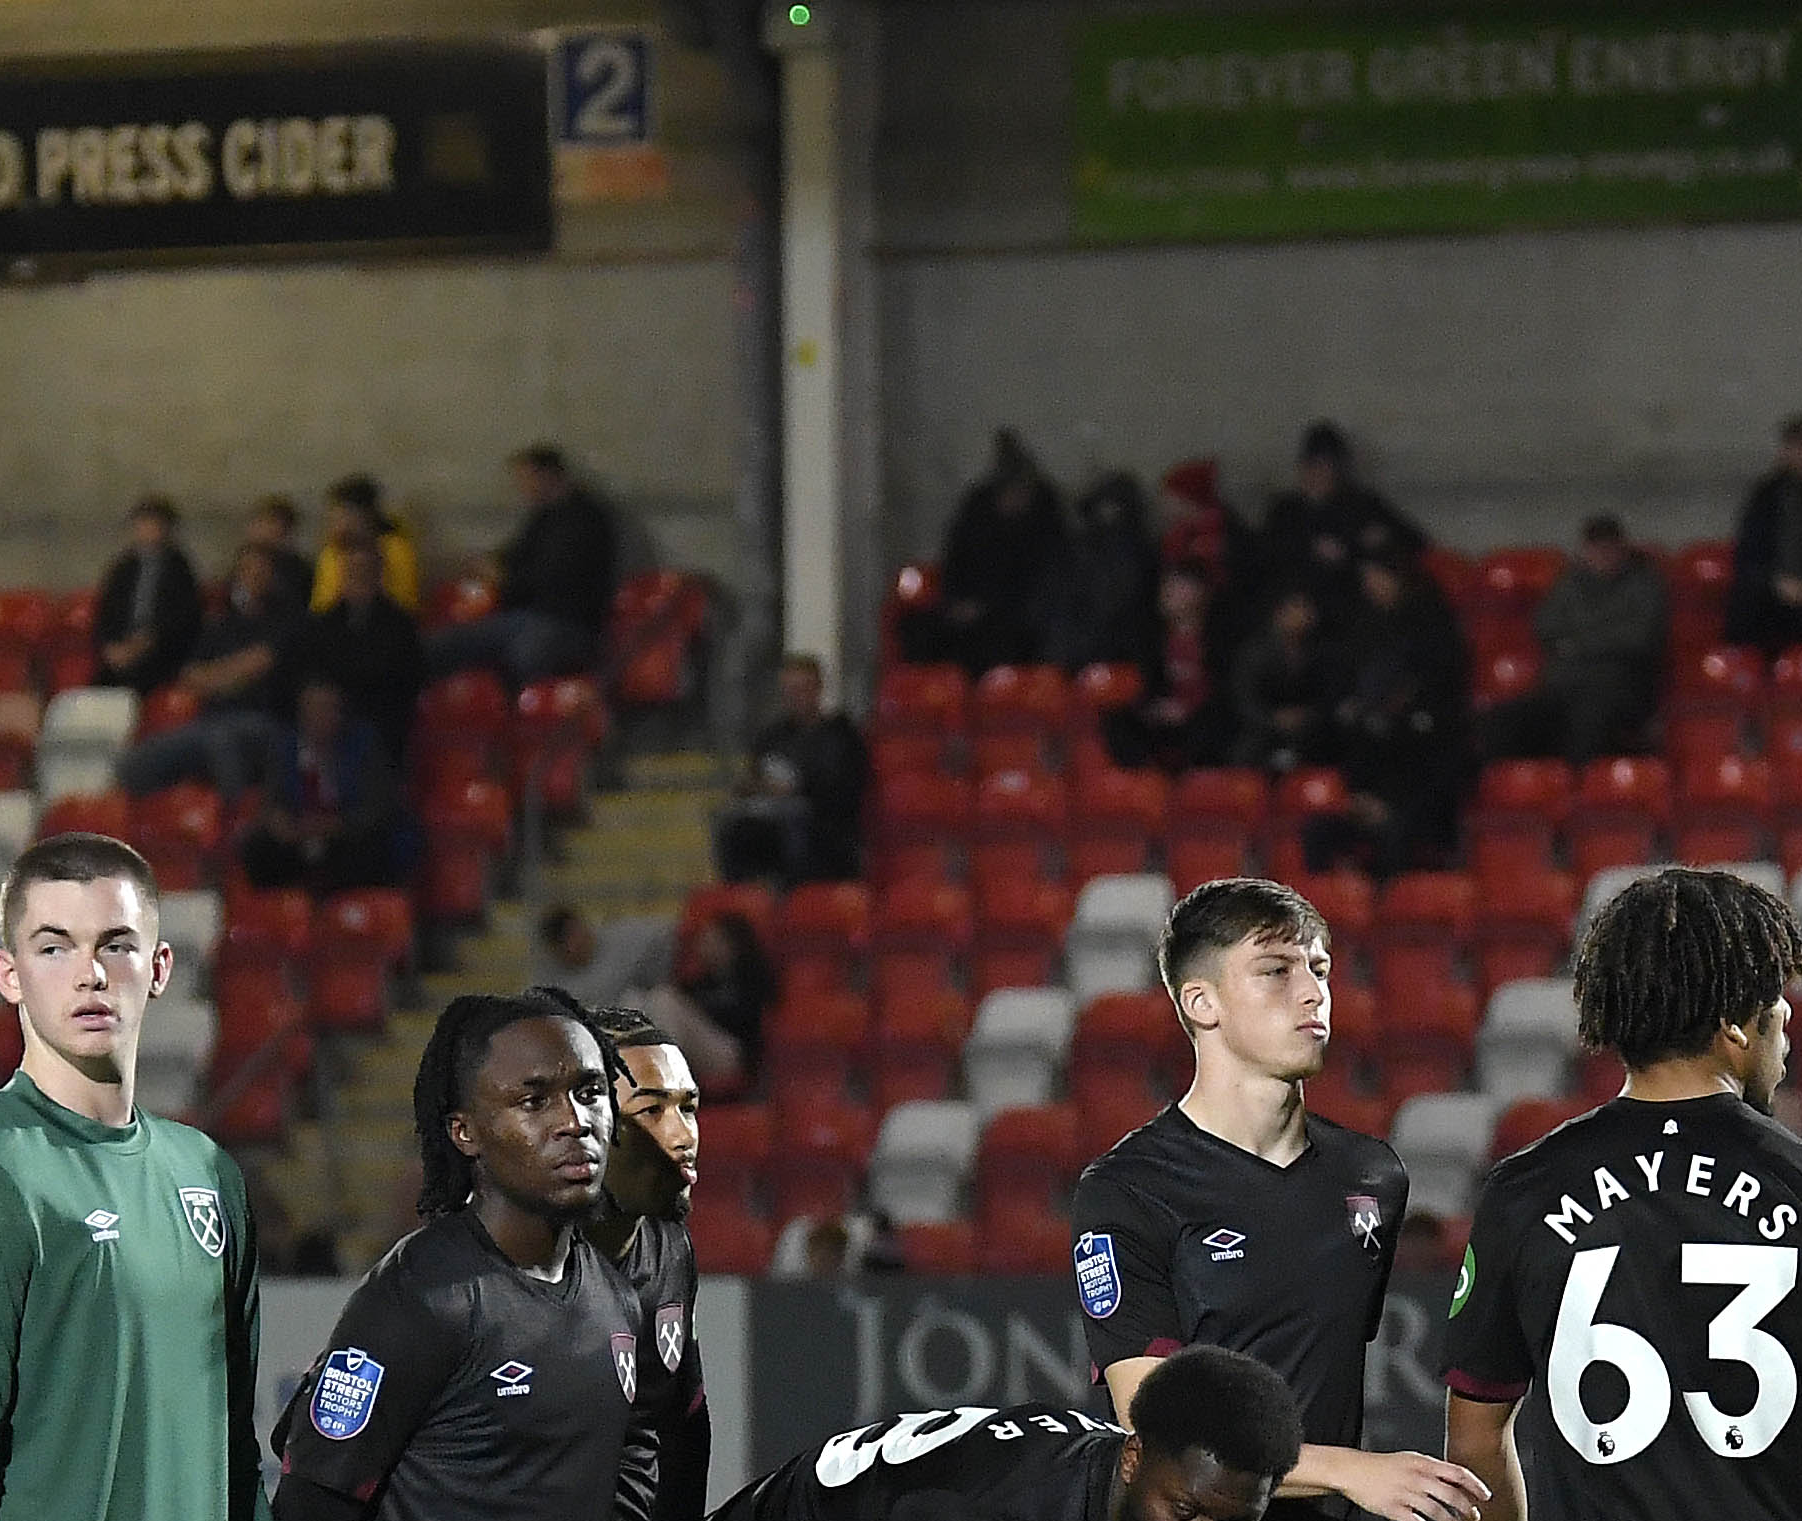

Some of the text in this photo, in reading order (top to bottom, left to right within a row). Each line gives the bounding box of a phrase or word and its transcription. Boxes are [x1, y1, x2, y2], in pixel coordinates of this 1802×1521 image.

[1108, 29, 1793, 111] FOREVER GREEN ENERGY
[573, 48, 640, 137] 2
[36, 121, 211, 202] PRESS
[222, 114, 394, 197] CIDER
[1543, 1151, 1798, 1245] MAYERS
[1211, 1249, 1245, 1261] umbro
[1547, 1242, 1798, 1465] 63
[322, 1378, 369, 1402] STREET
[324, 1366, 373, 1392] BRISTOL
[497, 1384, 530, 1397] umbro
[319, 1398, 360, 1419] TROPHY
[321, 1390, 364, 1410] MOTORS
